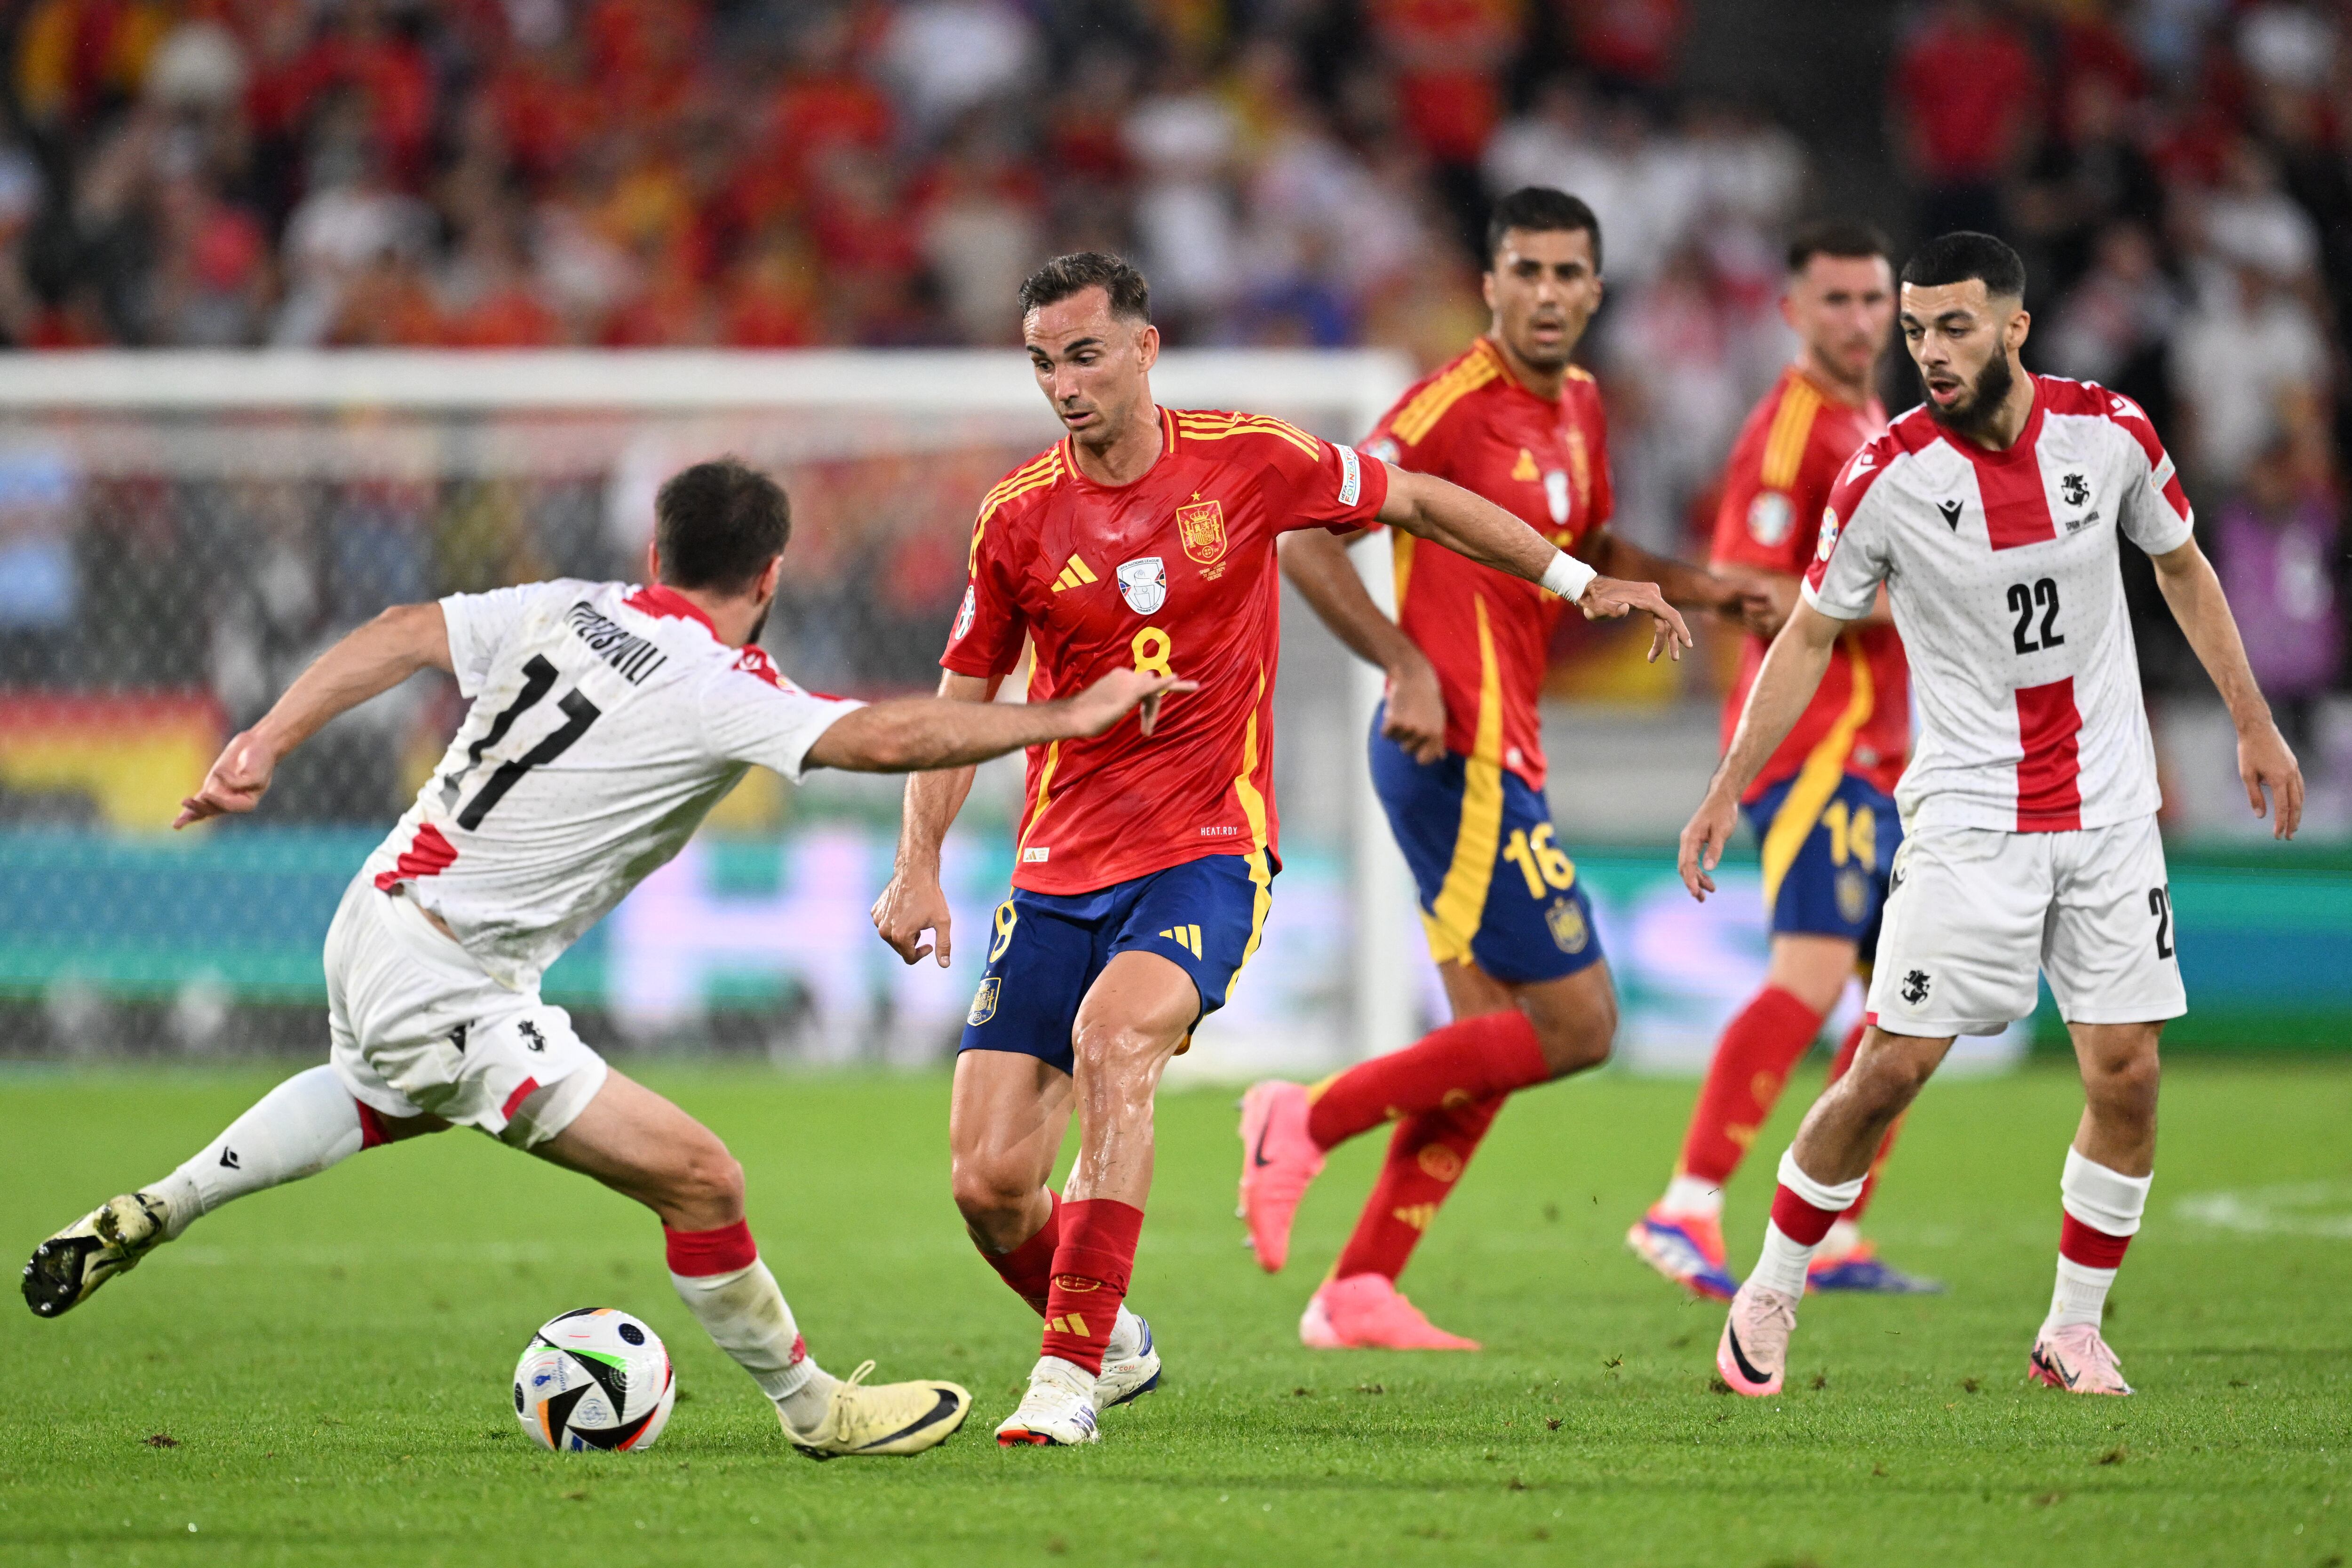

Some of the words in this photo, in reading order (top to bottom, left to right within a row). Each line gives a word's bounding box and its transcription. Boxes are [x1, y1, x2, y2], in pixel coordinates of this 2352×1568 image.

[2007, 578, 2065, 655] 22
[1131, 626, 1173, 697] 8
[1200, 826, 1237, 836] HEAT.RDY
[1503, 822, 1575, 899] 16
[1820, 800, 1876, 874] 14
[989, 899, 1017, 963] 8
[2148, 884, 2176, 960] 2
